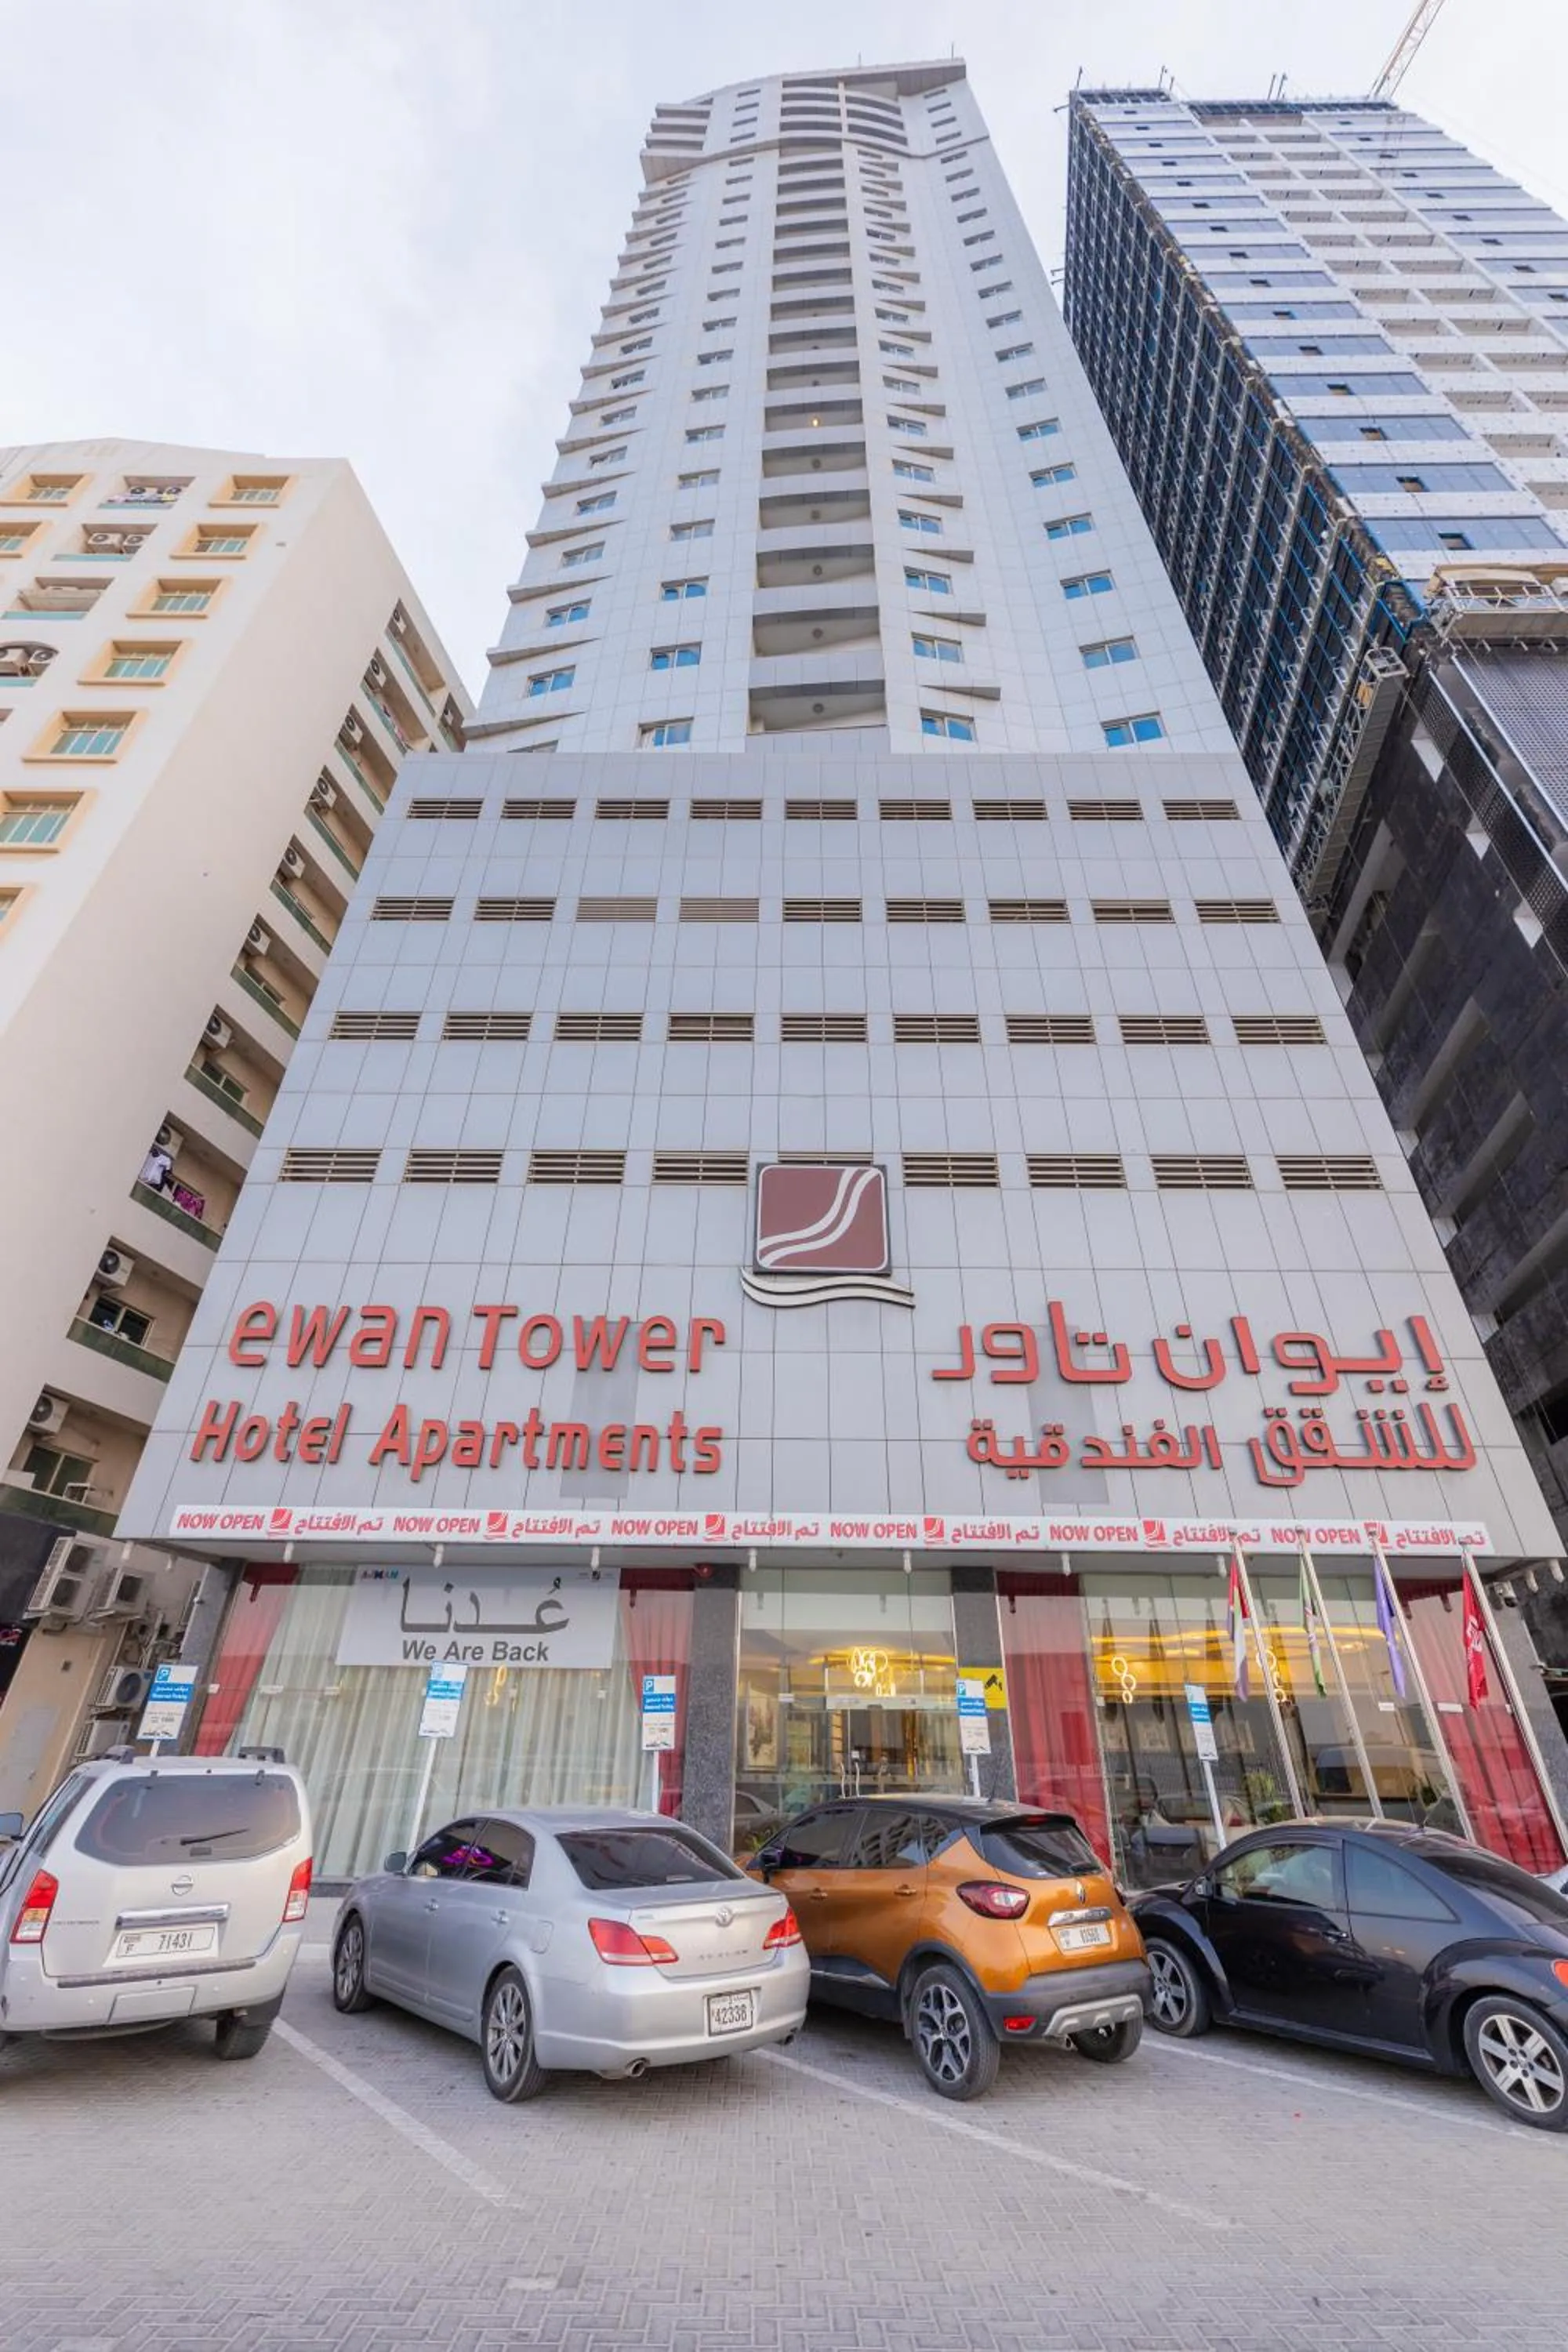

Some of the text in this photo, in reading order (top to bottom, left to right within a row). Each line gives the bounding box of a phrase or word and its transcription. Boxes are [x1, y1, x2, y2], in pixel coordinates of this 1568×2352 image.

[228, 1301, 726, 1372] ewan Tower
[931, 1301, 1450, 1396] إيوان تاور
[188, 1400, 724, 1481] Hotel Apartments
[967, 1403, 1477, 1486] للشقق الفندقية
[177, 1513, 265, 1530] NOW OPEN
[393, 1516, 481, 1534] NOW OPEN
[611, 1519, 699, 1536] NOW OPEN
[830, 1522, 917, 1538] NOW OPEN
[1050, 1524, 1139, 1541] NOW OPEN
[1315, 1528, 1361, 1544] OPEN
[402, 1640, 549, 1661] We Are Back
[158, 1932, 194, 1950] 71431
